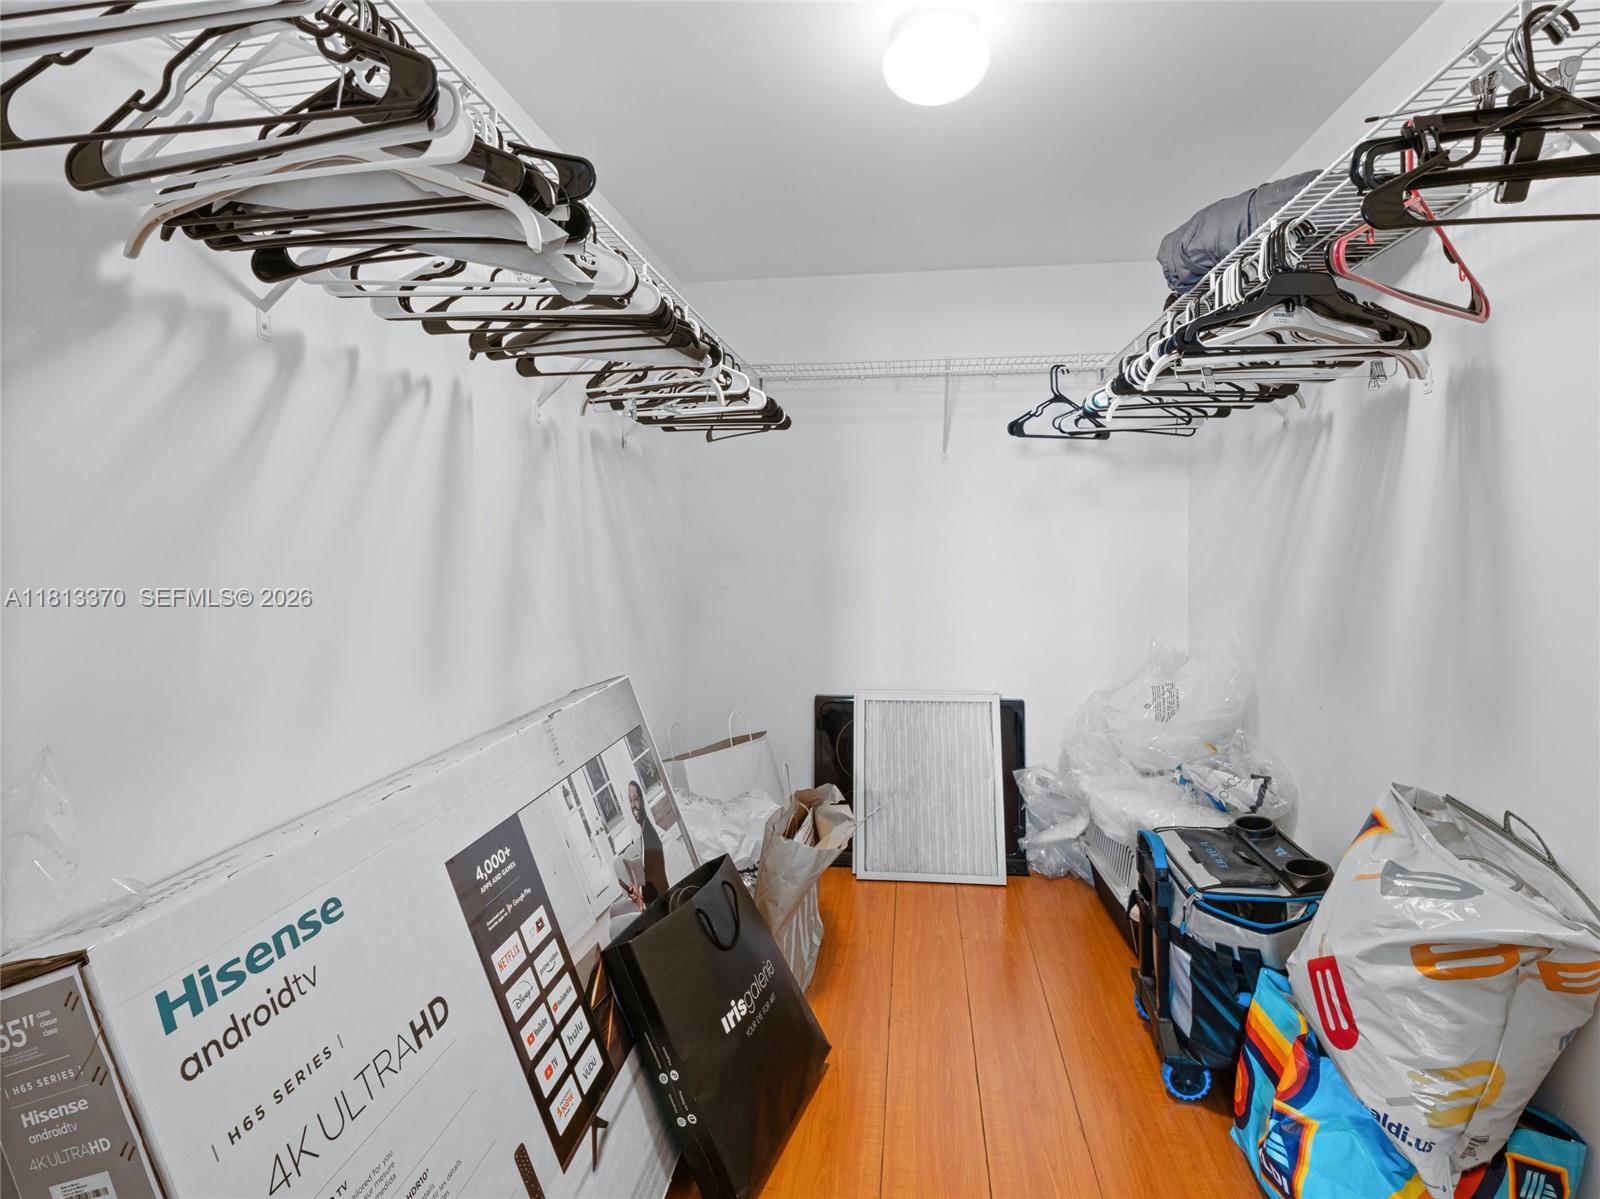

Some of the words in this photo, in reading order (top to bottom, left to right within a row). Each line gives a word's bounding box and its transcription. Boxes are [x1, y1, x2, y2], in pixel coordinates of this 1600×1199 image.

[476, 846, 510, 880] 4,000+
[155, 897, 344, 1036] Hisense
[497, 943, 521, 973] NETFLIX
[567, 1021, 584, 1046] hulu
[12, 1082, 33, 1095] H65
[36, 1069, 75, 1087] SERIES
[227, 1105, 266, 1145] H65
[273, 1046, 332, 1104] SERIES
[21, 1099, 89, 1128] Hisense
[269, 1124, 320, 1196] 4K
[372, 1163, 381, 1177] for
[382, 1150, 393, 1166] you
[336, 1180, 347, 1197] TV
